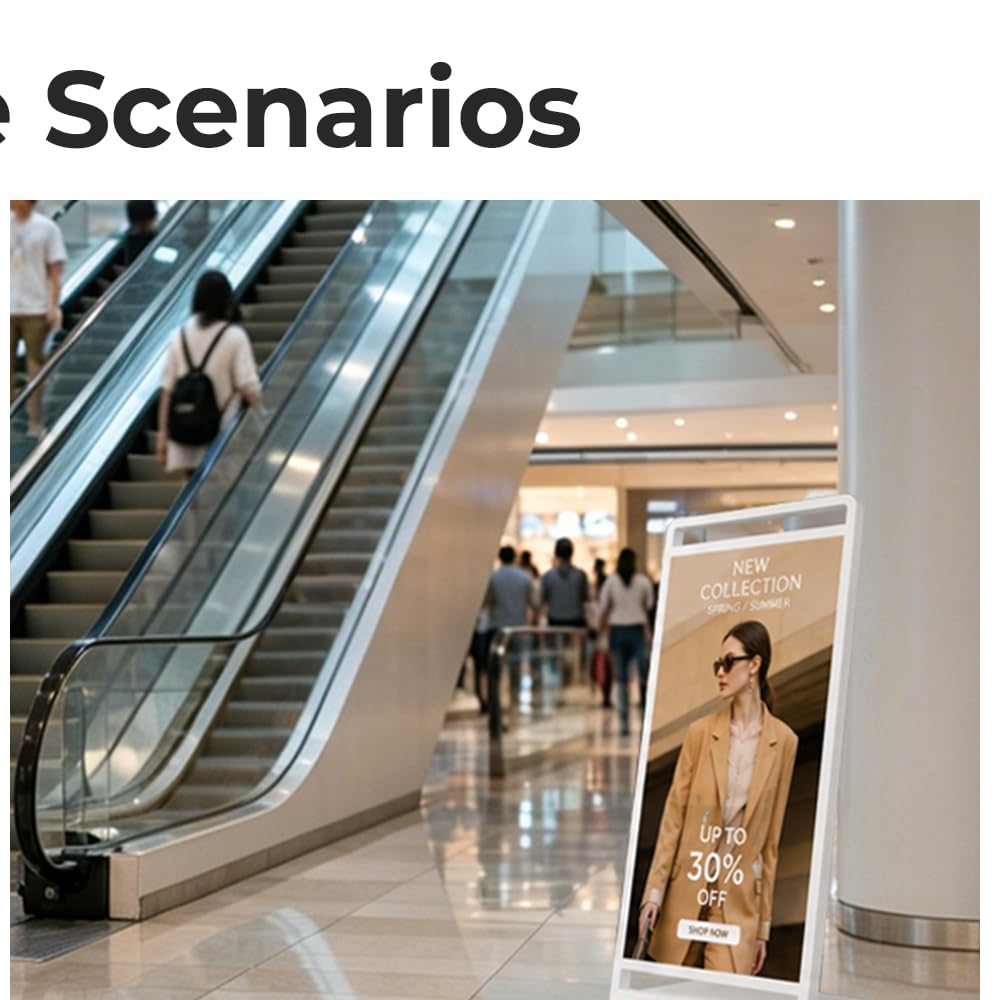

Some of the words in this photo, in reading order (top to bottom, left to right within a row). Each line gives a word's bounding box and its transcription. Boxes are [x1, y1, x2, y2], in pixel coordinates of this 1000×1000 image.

[732, 556, 770, 576] NEW
[700, 574, 803, 600] COLLECTION
[700, 824, 722, 843] UP
[724, 826, 747, 845] TO
[687, 851, 744, 885] 30%
[697, 888, 728, 907] OFF
